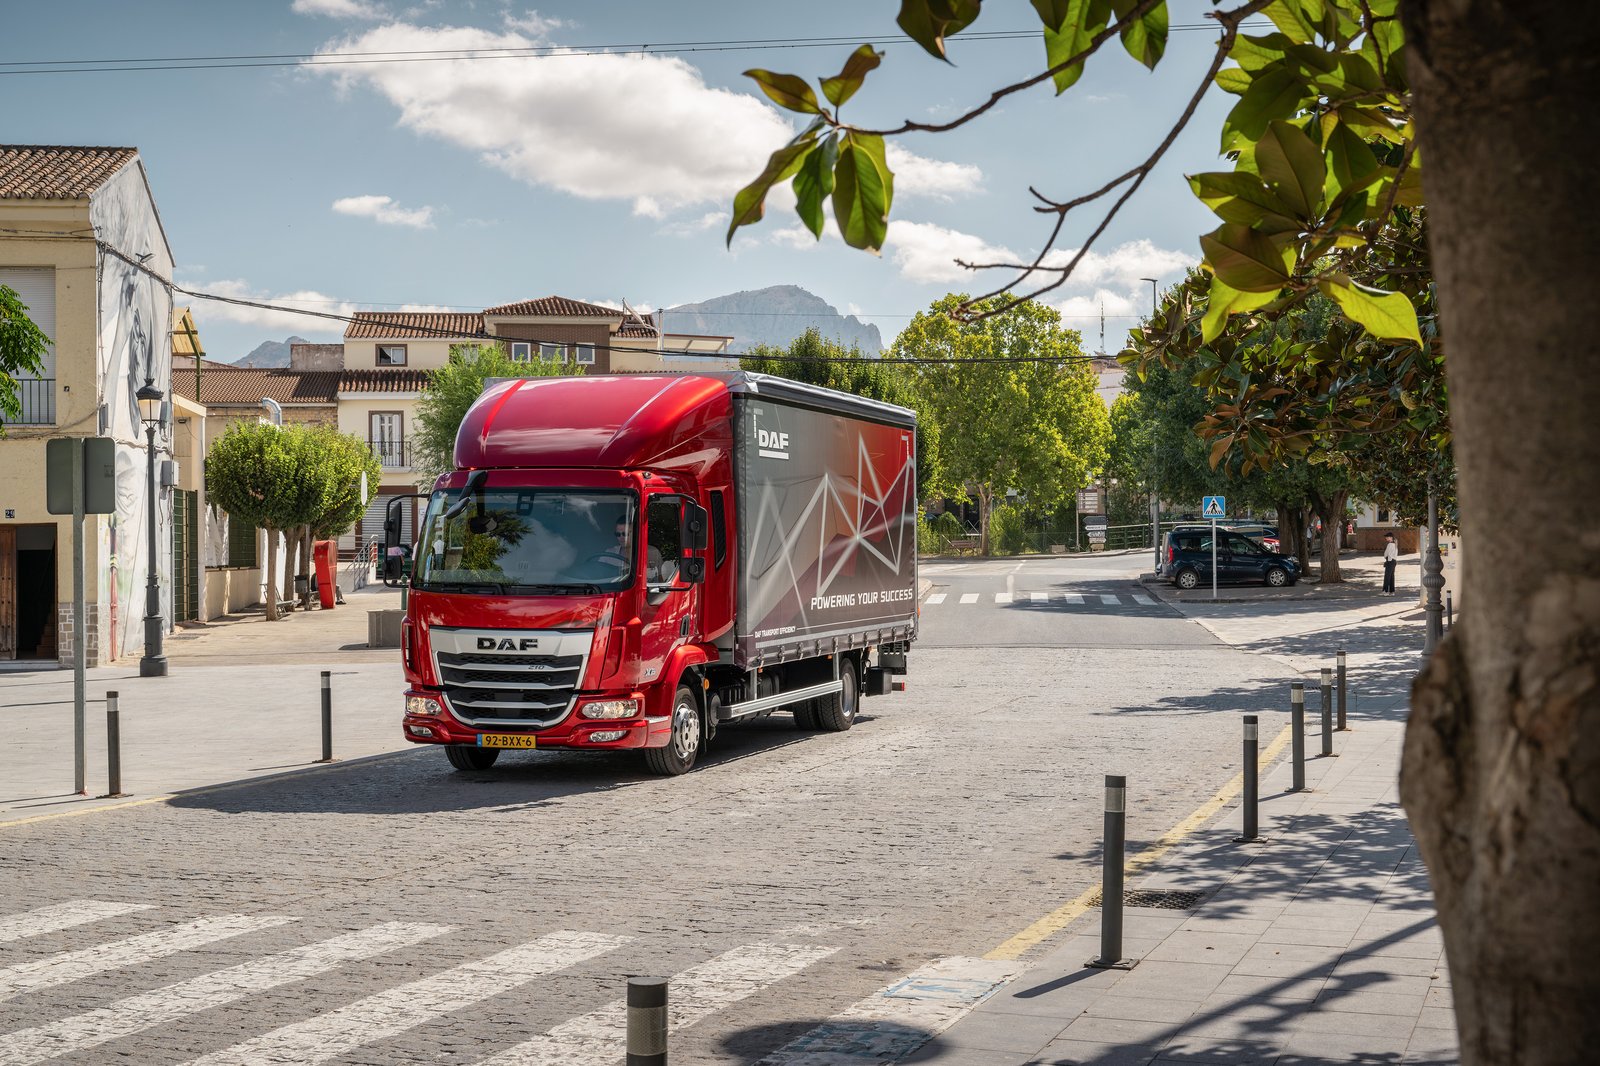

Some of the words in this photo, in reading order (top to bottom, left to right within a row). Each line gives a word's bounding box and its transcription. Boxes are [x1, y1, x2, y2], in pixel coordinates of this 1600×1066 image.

[758, 429, 789, 449] DAF
[811, 594, 855, 610] POWERING
[857, 592, 879, 604] YOUR
[880, 588, 913, 603] SUCCESS
[761, 628, 780, 637] TRANSPORT
[779, 625, 796, 635] EFFICIENCY
[477, 637, 538, 651] DAF
[485, 735, 532, 747] 92-BXX-6
